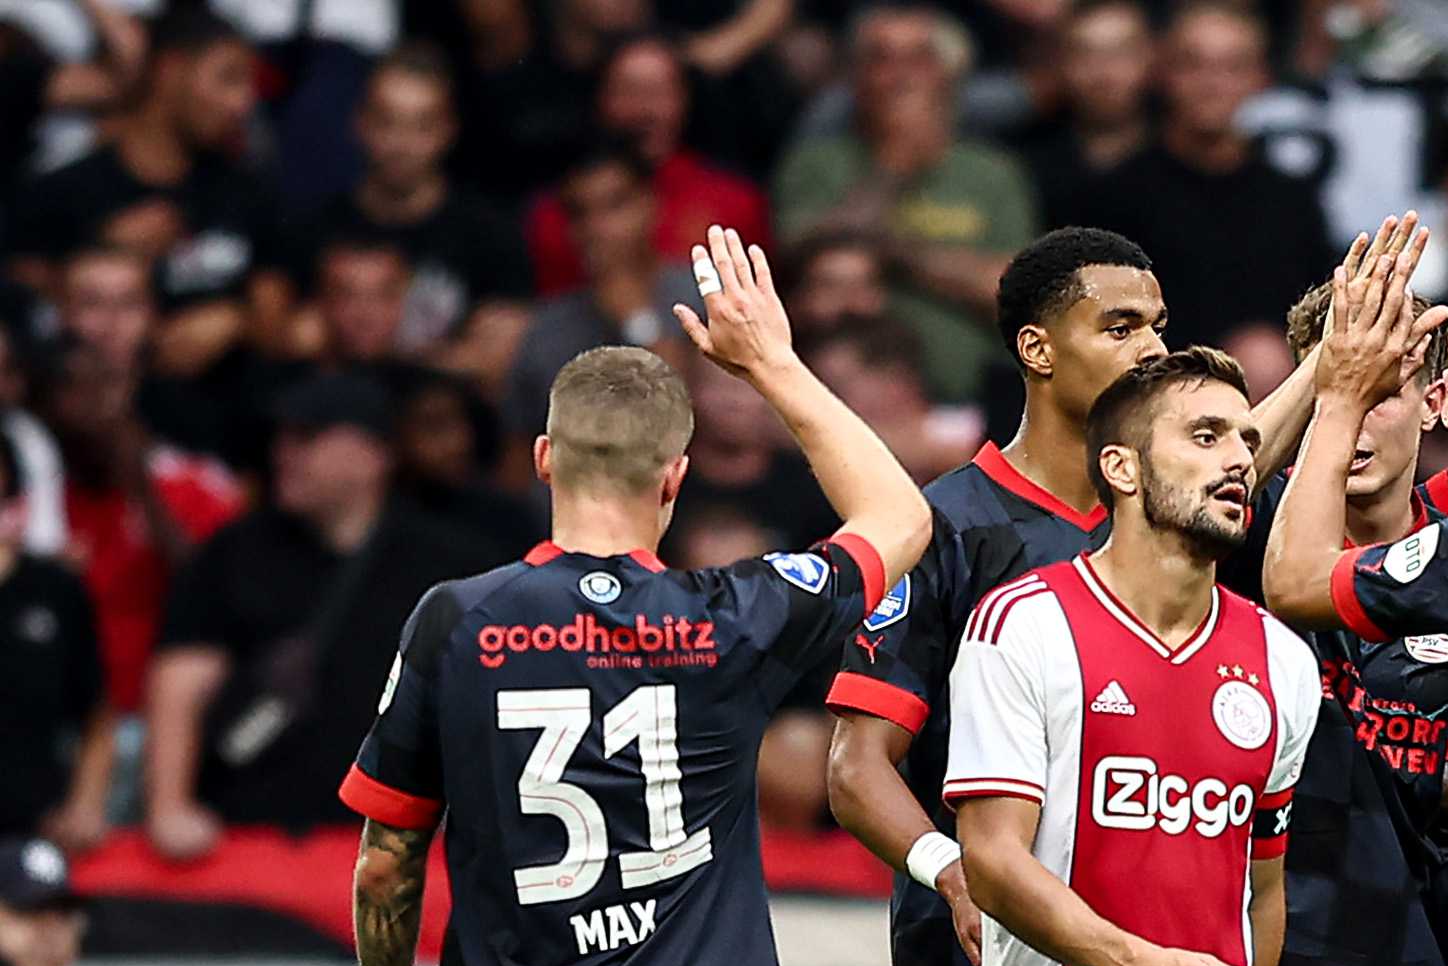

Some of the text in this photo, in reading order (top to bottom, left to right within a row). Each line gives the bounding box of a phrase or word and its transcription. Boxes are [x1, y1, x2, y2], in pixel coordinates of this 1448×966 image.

[1404, 537, 1421, 574] OTO
[478, 613, 716, 668] goodhabitz
[1090, 700, 1136, 716] adidas
[497, 684, 714, 906] 31
[570, 900, 657, 955] MAX
